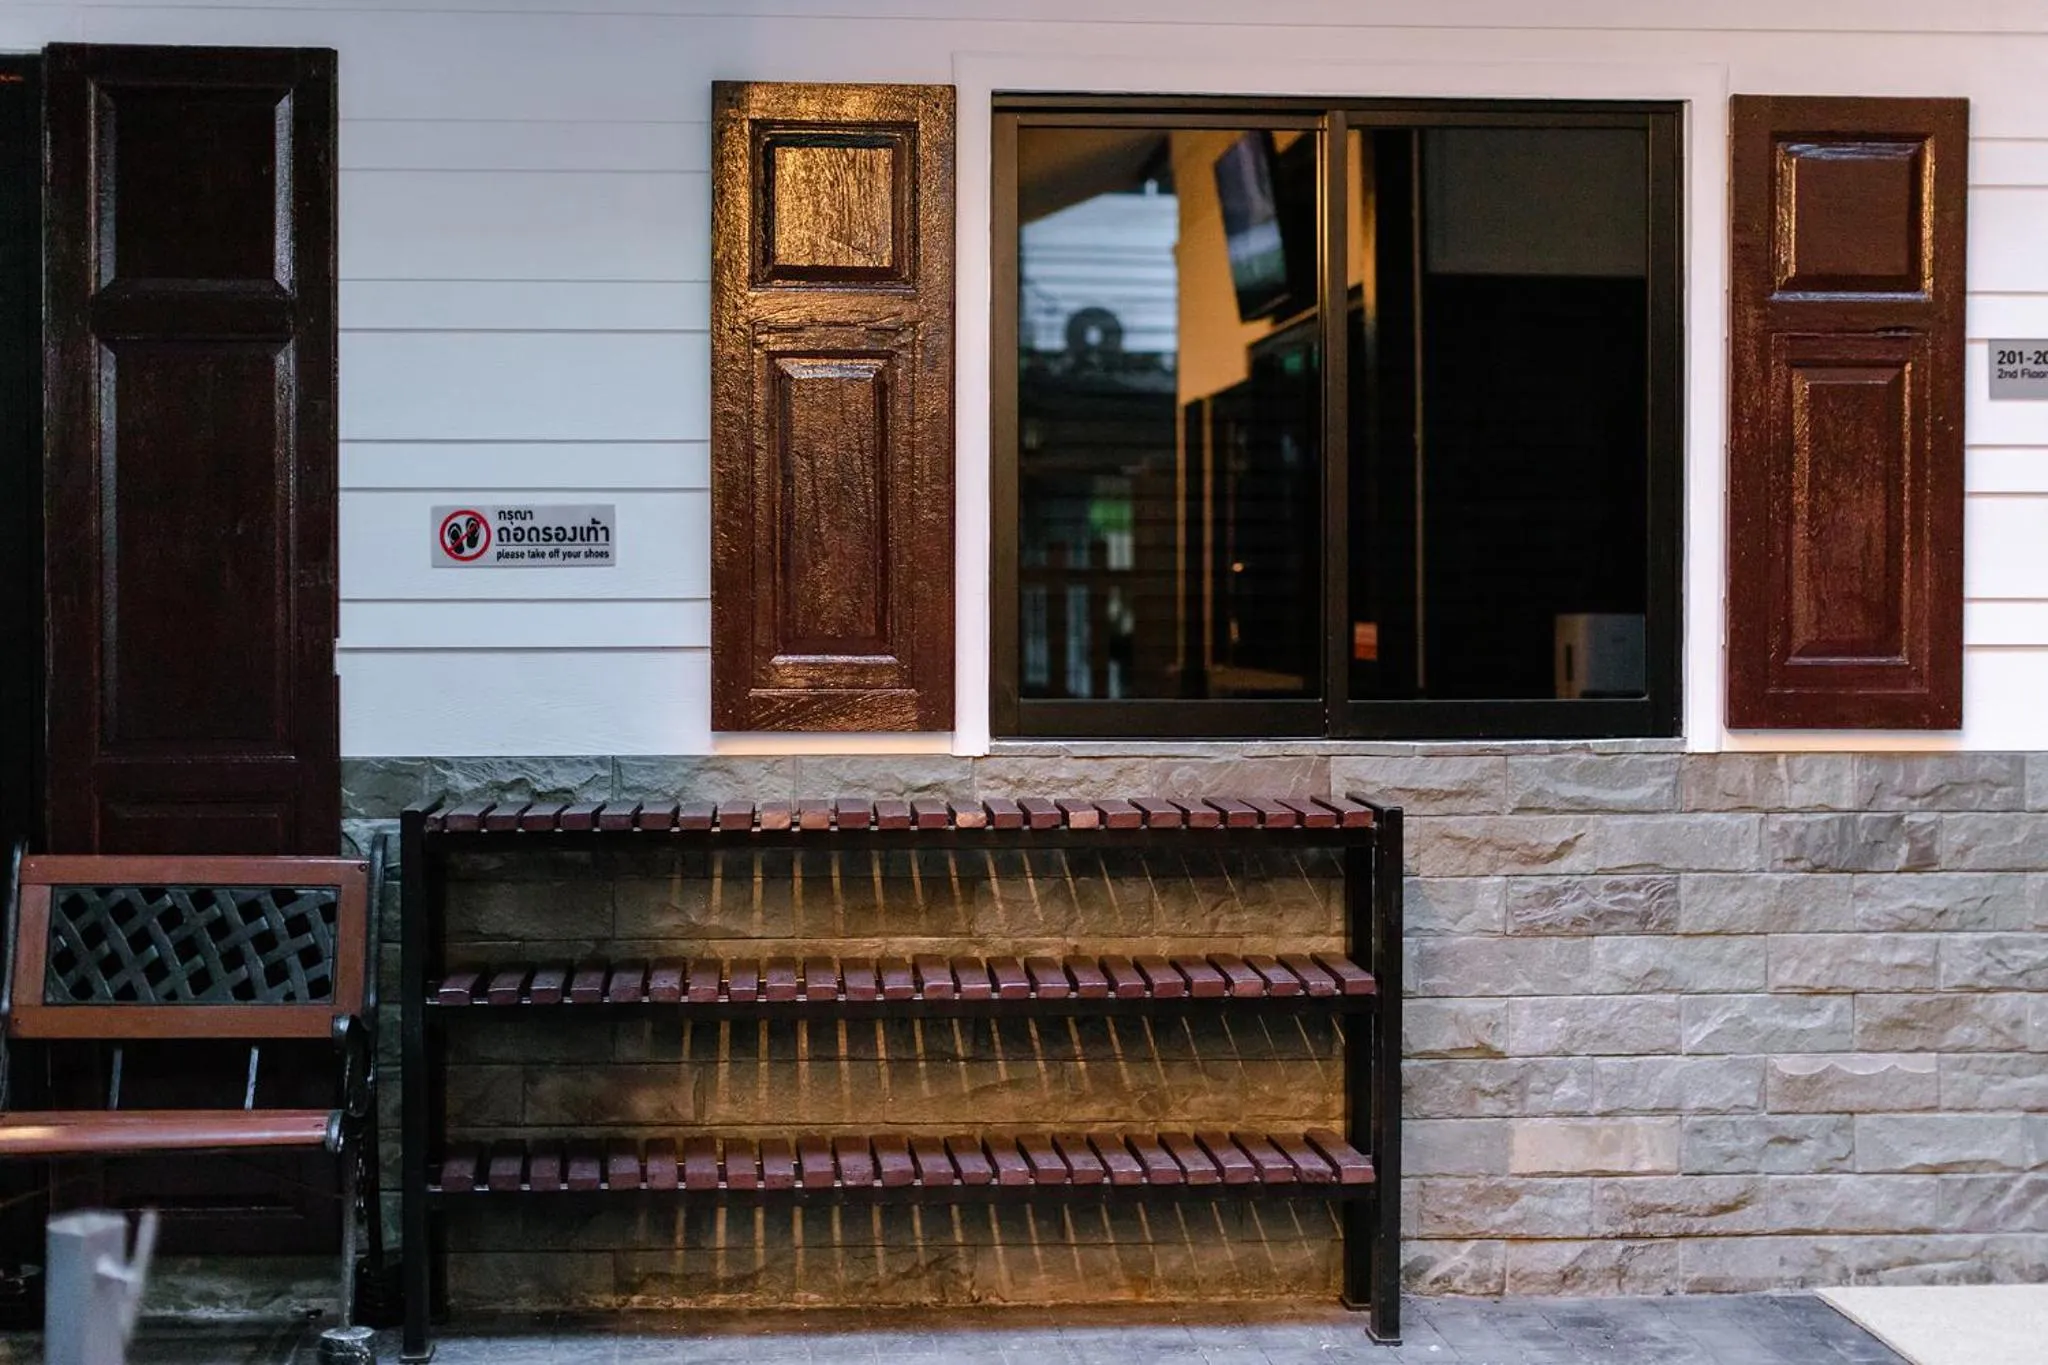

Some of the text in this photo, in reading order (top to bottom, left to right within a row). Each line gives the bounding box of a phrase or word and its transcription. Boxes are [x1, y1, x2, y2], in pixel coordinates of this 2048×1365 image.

[1998, 368, 2018, 379] 2nd
[498, 509, 533, 525] กรุณา
[497, 518, 609, 542] ถอดรองเท้า
[497, 549, 609, 561] please take off your shoes
